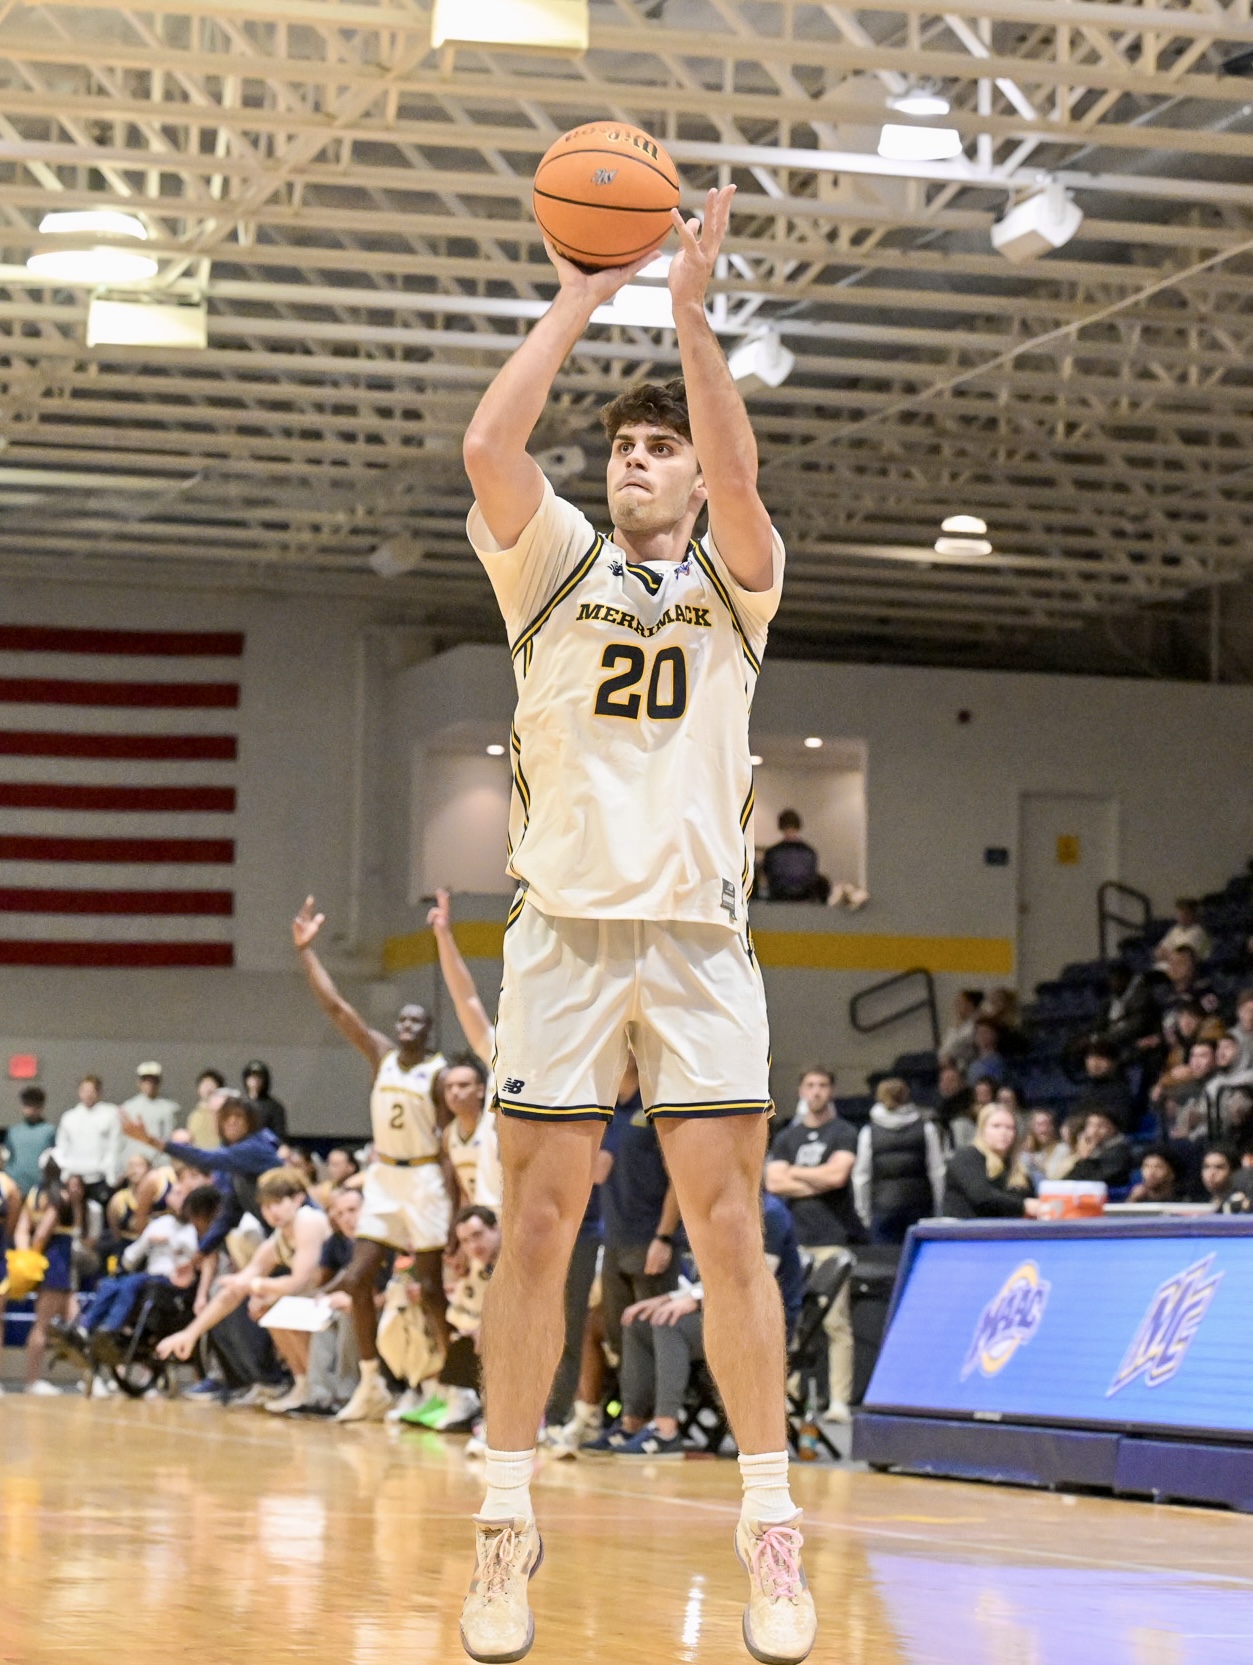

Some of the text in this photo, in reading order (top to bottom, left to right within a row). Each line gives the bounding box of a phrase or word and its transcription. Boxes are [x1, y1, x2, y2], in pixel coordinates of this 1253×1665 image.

[575, 602, 713, 638] MERRIMACK
[593, 642, 688, 721] 20
[390, 1103, 405, 1130] 2
